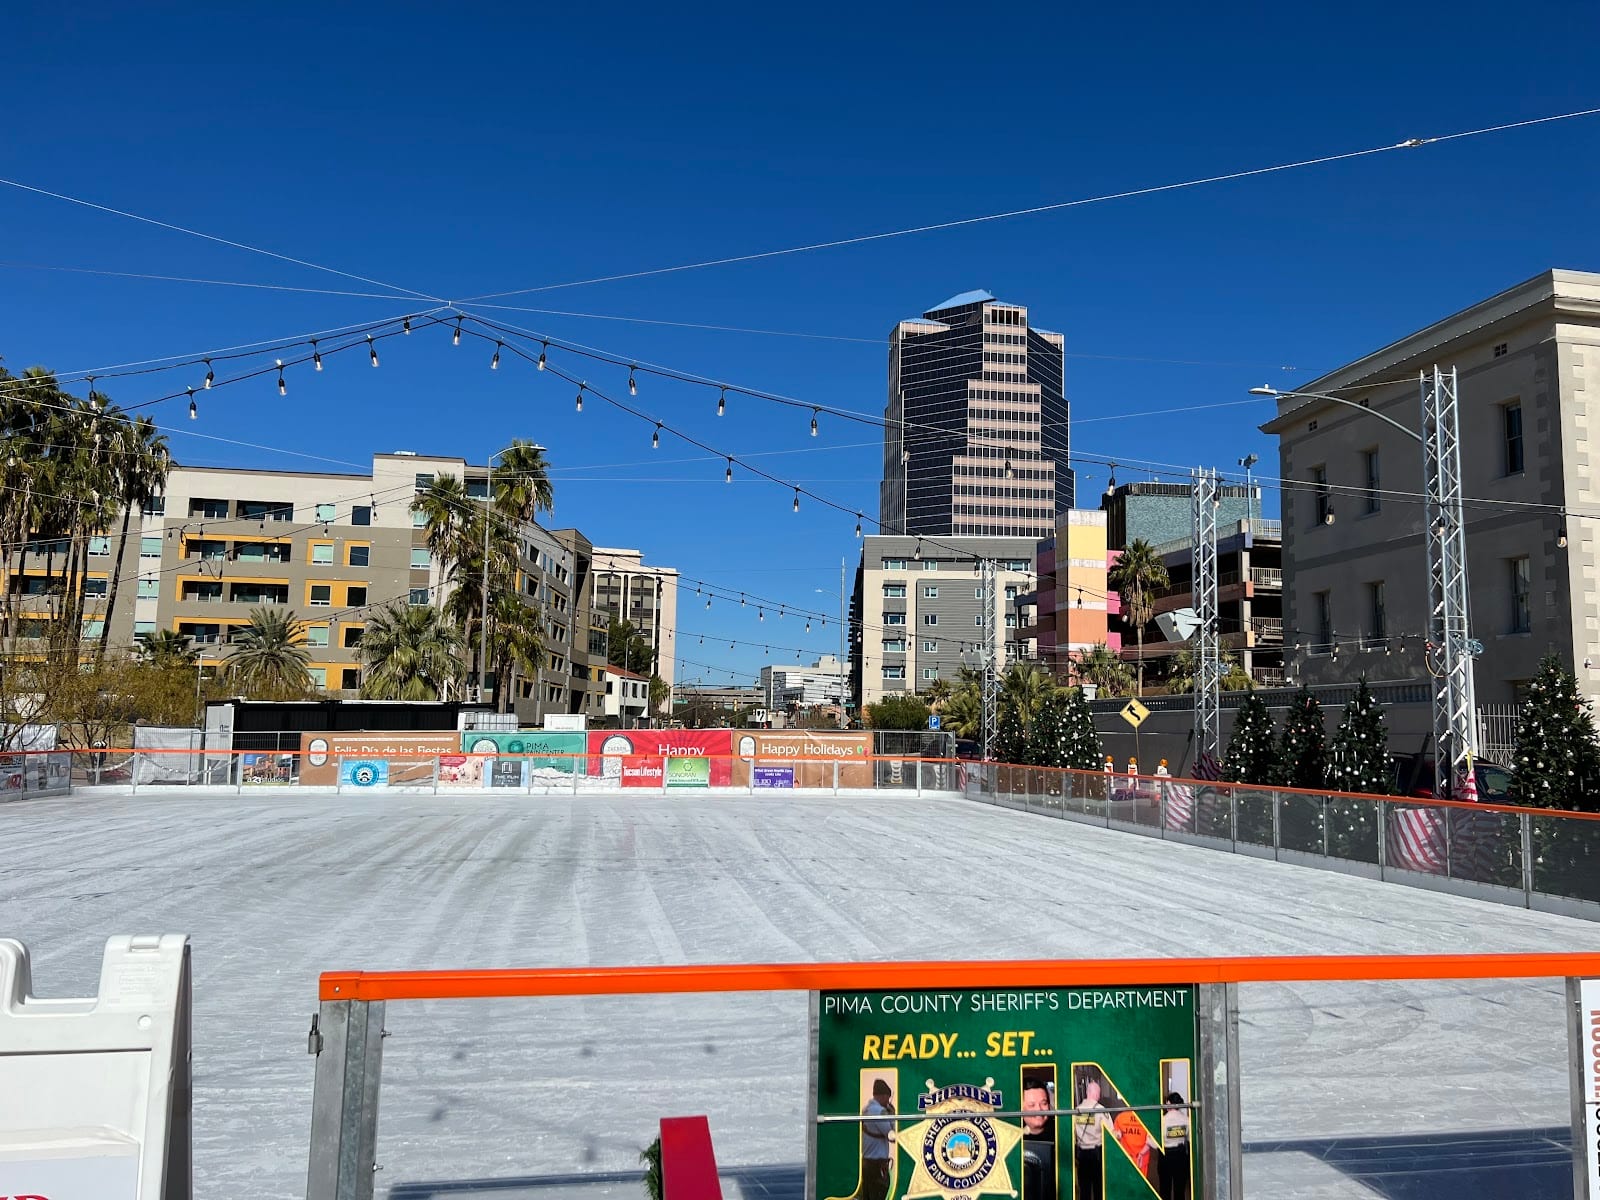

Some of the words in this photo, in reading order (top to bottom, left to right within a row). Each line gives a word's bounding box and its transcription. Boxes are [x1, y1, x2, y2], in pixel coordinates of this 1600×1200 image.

[931, 717, 938, 726] P
[382, 746, 397, 757] de
[526, 742, 549, 750] PIMA
[658, 743, 705, 756] Happy
[761, 743, 800, 757] Happy
[803, 743, 853, 758] Holidays
[825, 996, 873, 1015] PIMA
[881, 994, 963, 1014] COUNTY
[971, 992, 1059, 1013] SHERIFF'S
[1068, 989, 1188, 1010] DEPARTMENT
[862, 1032, 977, 1061] READY...
[985, 1031, 1053, 1057] SET...
[924, 1085, 997, 1106] SHERIFF
[1124, 1127, 1142, 1136] JAIL
[928, 1164, 950, 1187] PIMA
[953, 1160, 993, 1189] COUNTY
